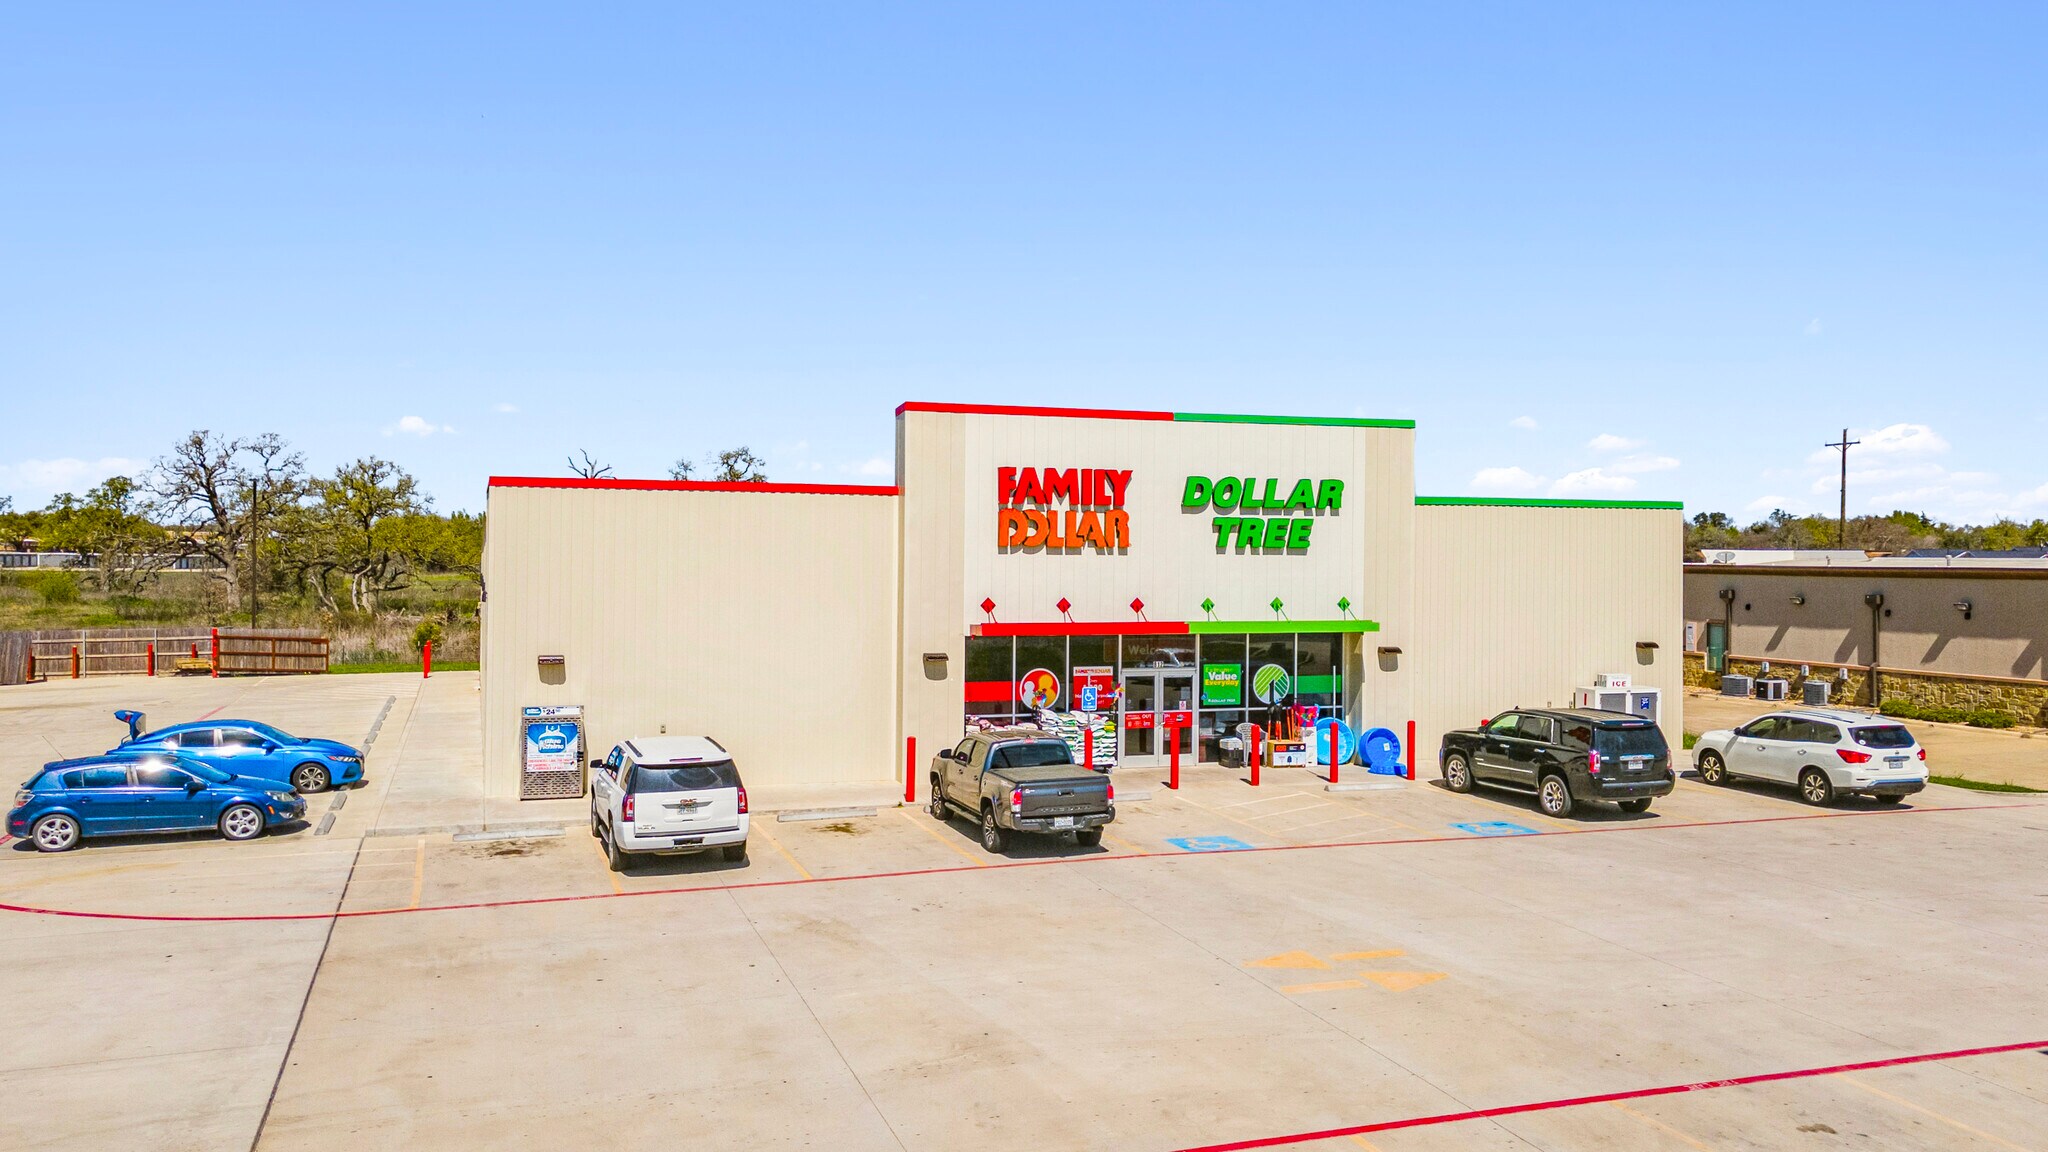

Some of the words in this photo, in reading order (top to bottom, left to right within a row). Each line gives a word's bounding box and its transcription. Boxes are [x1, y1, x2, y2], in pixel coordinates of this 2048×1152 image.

[997, 466, 1133, 506] FAMILY
[1181, 476, 1345, 509] DOLLAR
[997, 508, 1131, 548] DOLLAR
[1212, 517, 1314, 549] TREE
[1205, 679, 1239, 687] Everyday
[1208, 671, 1238, 681] Value
